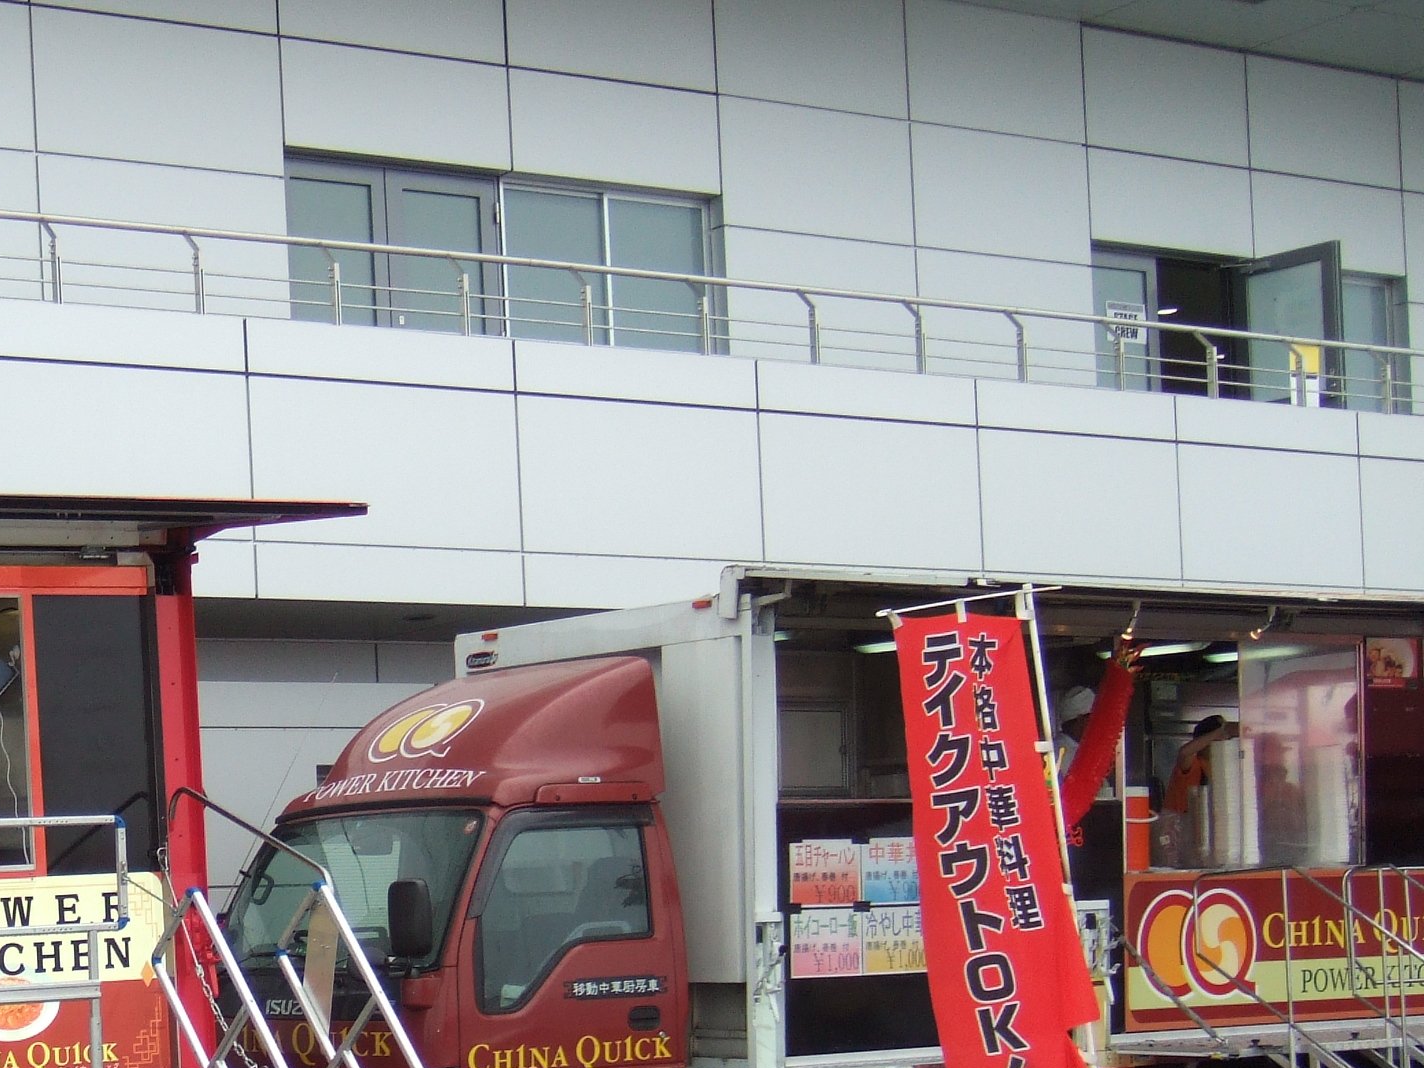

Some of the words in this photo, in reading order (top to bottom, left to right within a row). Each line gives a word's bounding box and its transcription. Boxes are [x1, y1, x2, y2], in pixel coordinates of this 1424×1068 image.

[303, 772, 373, 802] POWER
[375, 768, 487, 793] KITCHEN
[969, 634, 1044, 932] 本格中華料理
[1263, 911, 1366, 949] CHINA
[266, 999, 304, 1015] ISUZ
